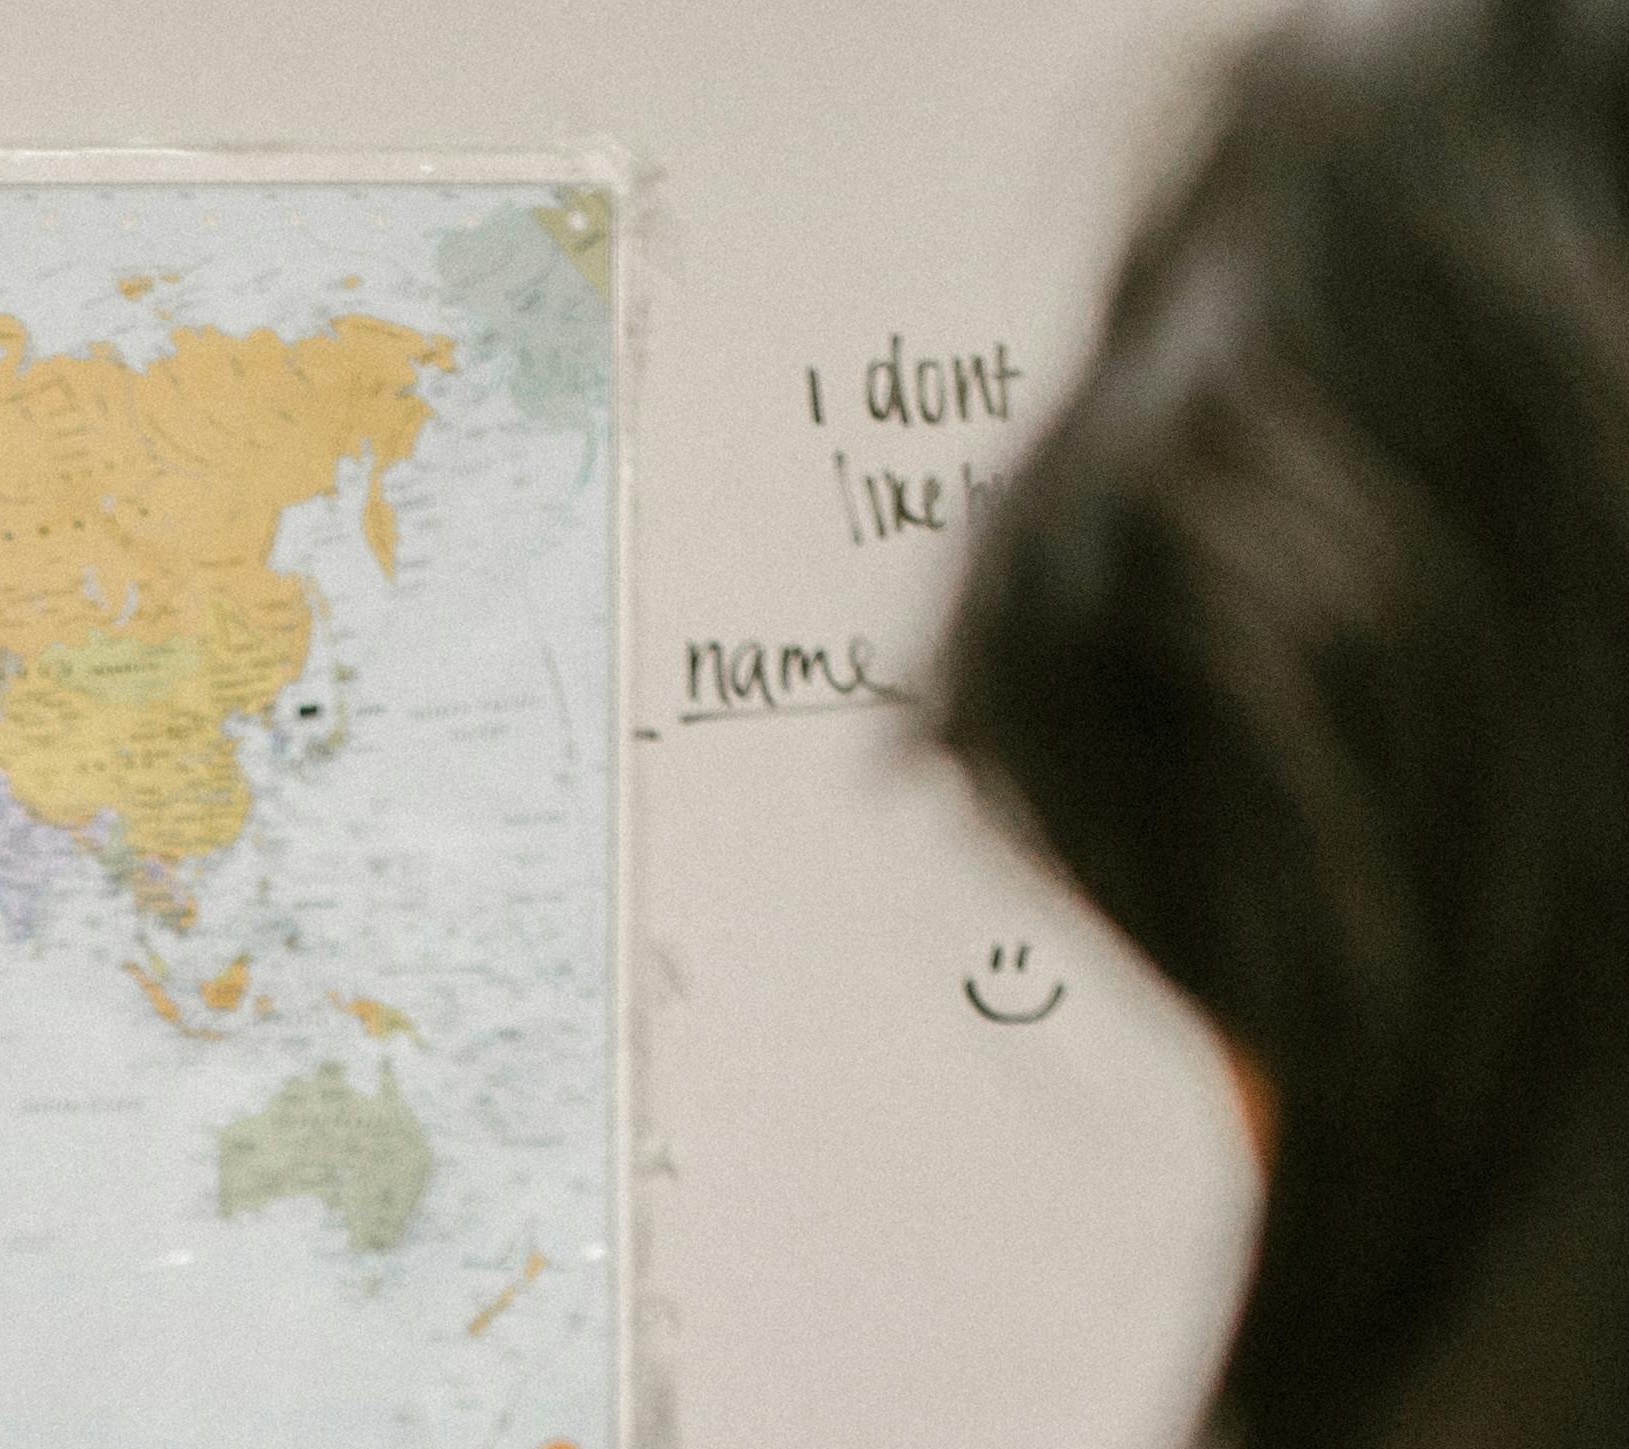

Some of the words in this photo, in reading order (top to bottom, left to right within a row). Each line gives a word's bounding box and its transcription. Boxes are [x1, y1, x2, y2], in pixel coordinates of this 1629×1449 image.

[864, 334, 1021, 426] dont
[834, 450, 946, 546] like
[686, 637, 900, 709] name
